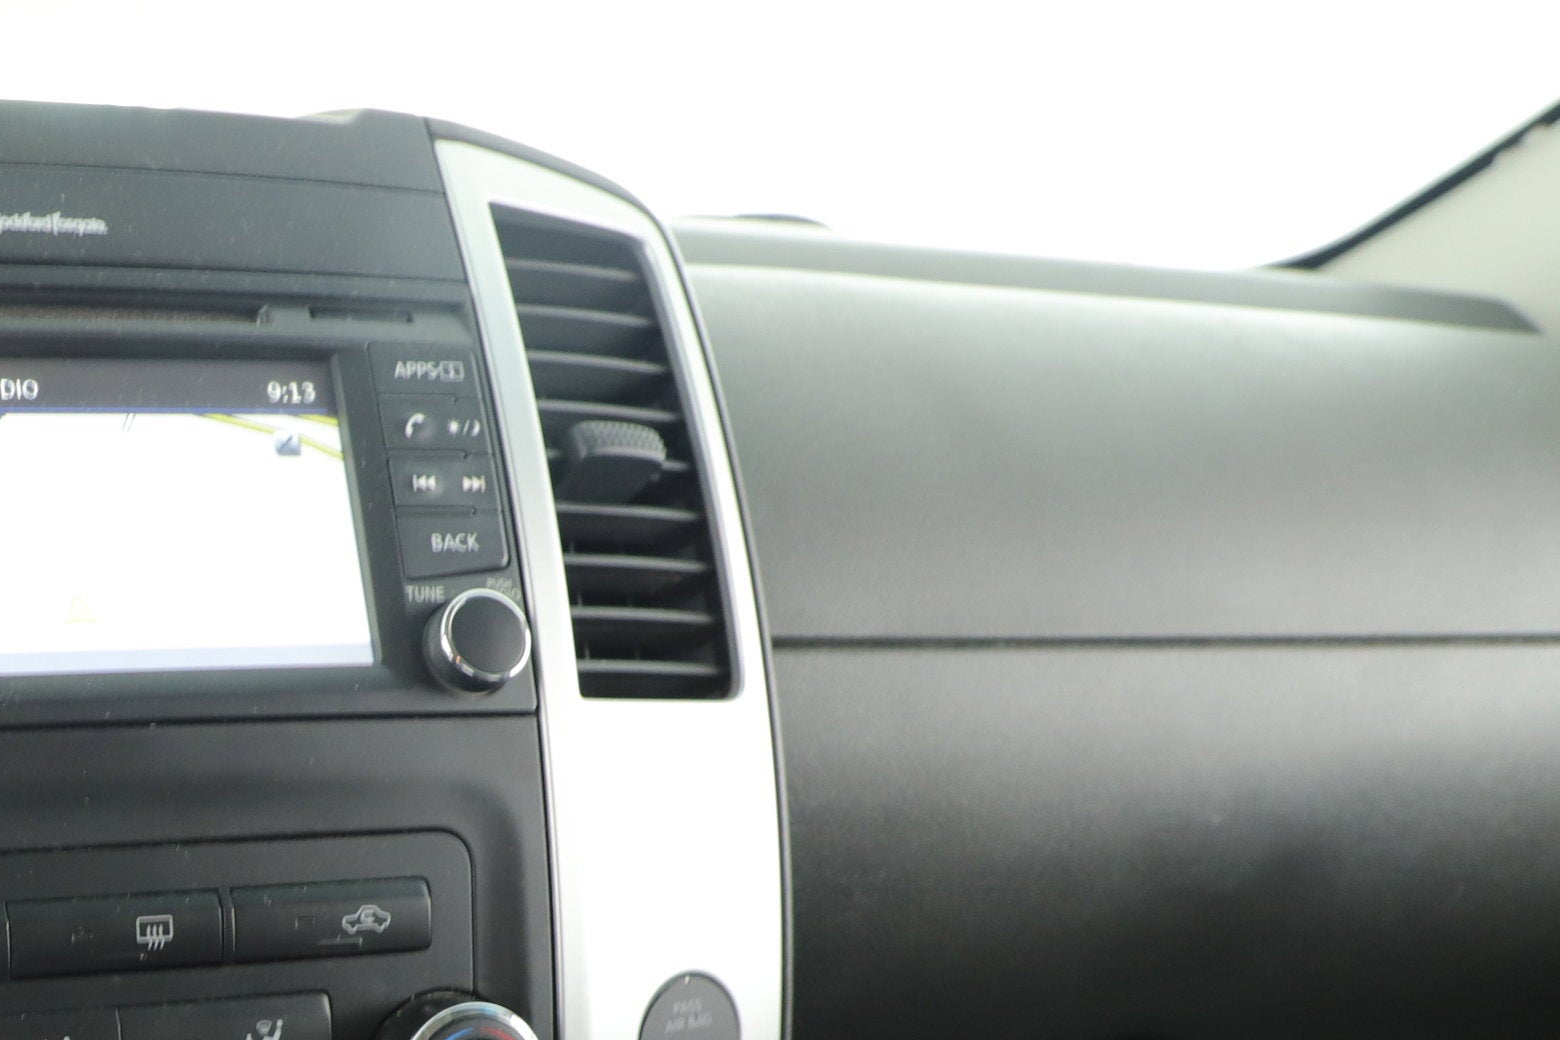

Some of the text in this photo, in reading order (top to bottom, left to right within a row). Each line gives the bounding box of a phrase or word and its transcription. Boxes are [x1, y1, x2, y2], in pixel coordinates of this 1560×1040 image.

[394, 361, 439, 380] APPS
[430, 532, 480, 553] BACK
[406, 586, 445, 602] TUNE
